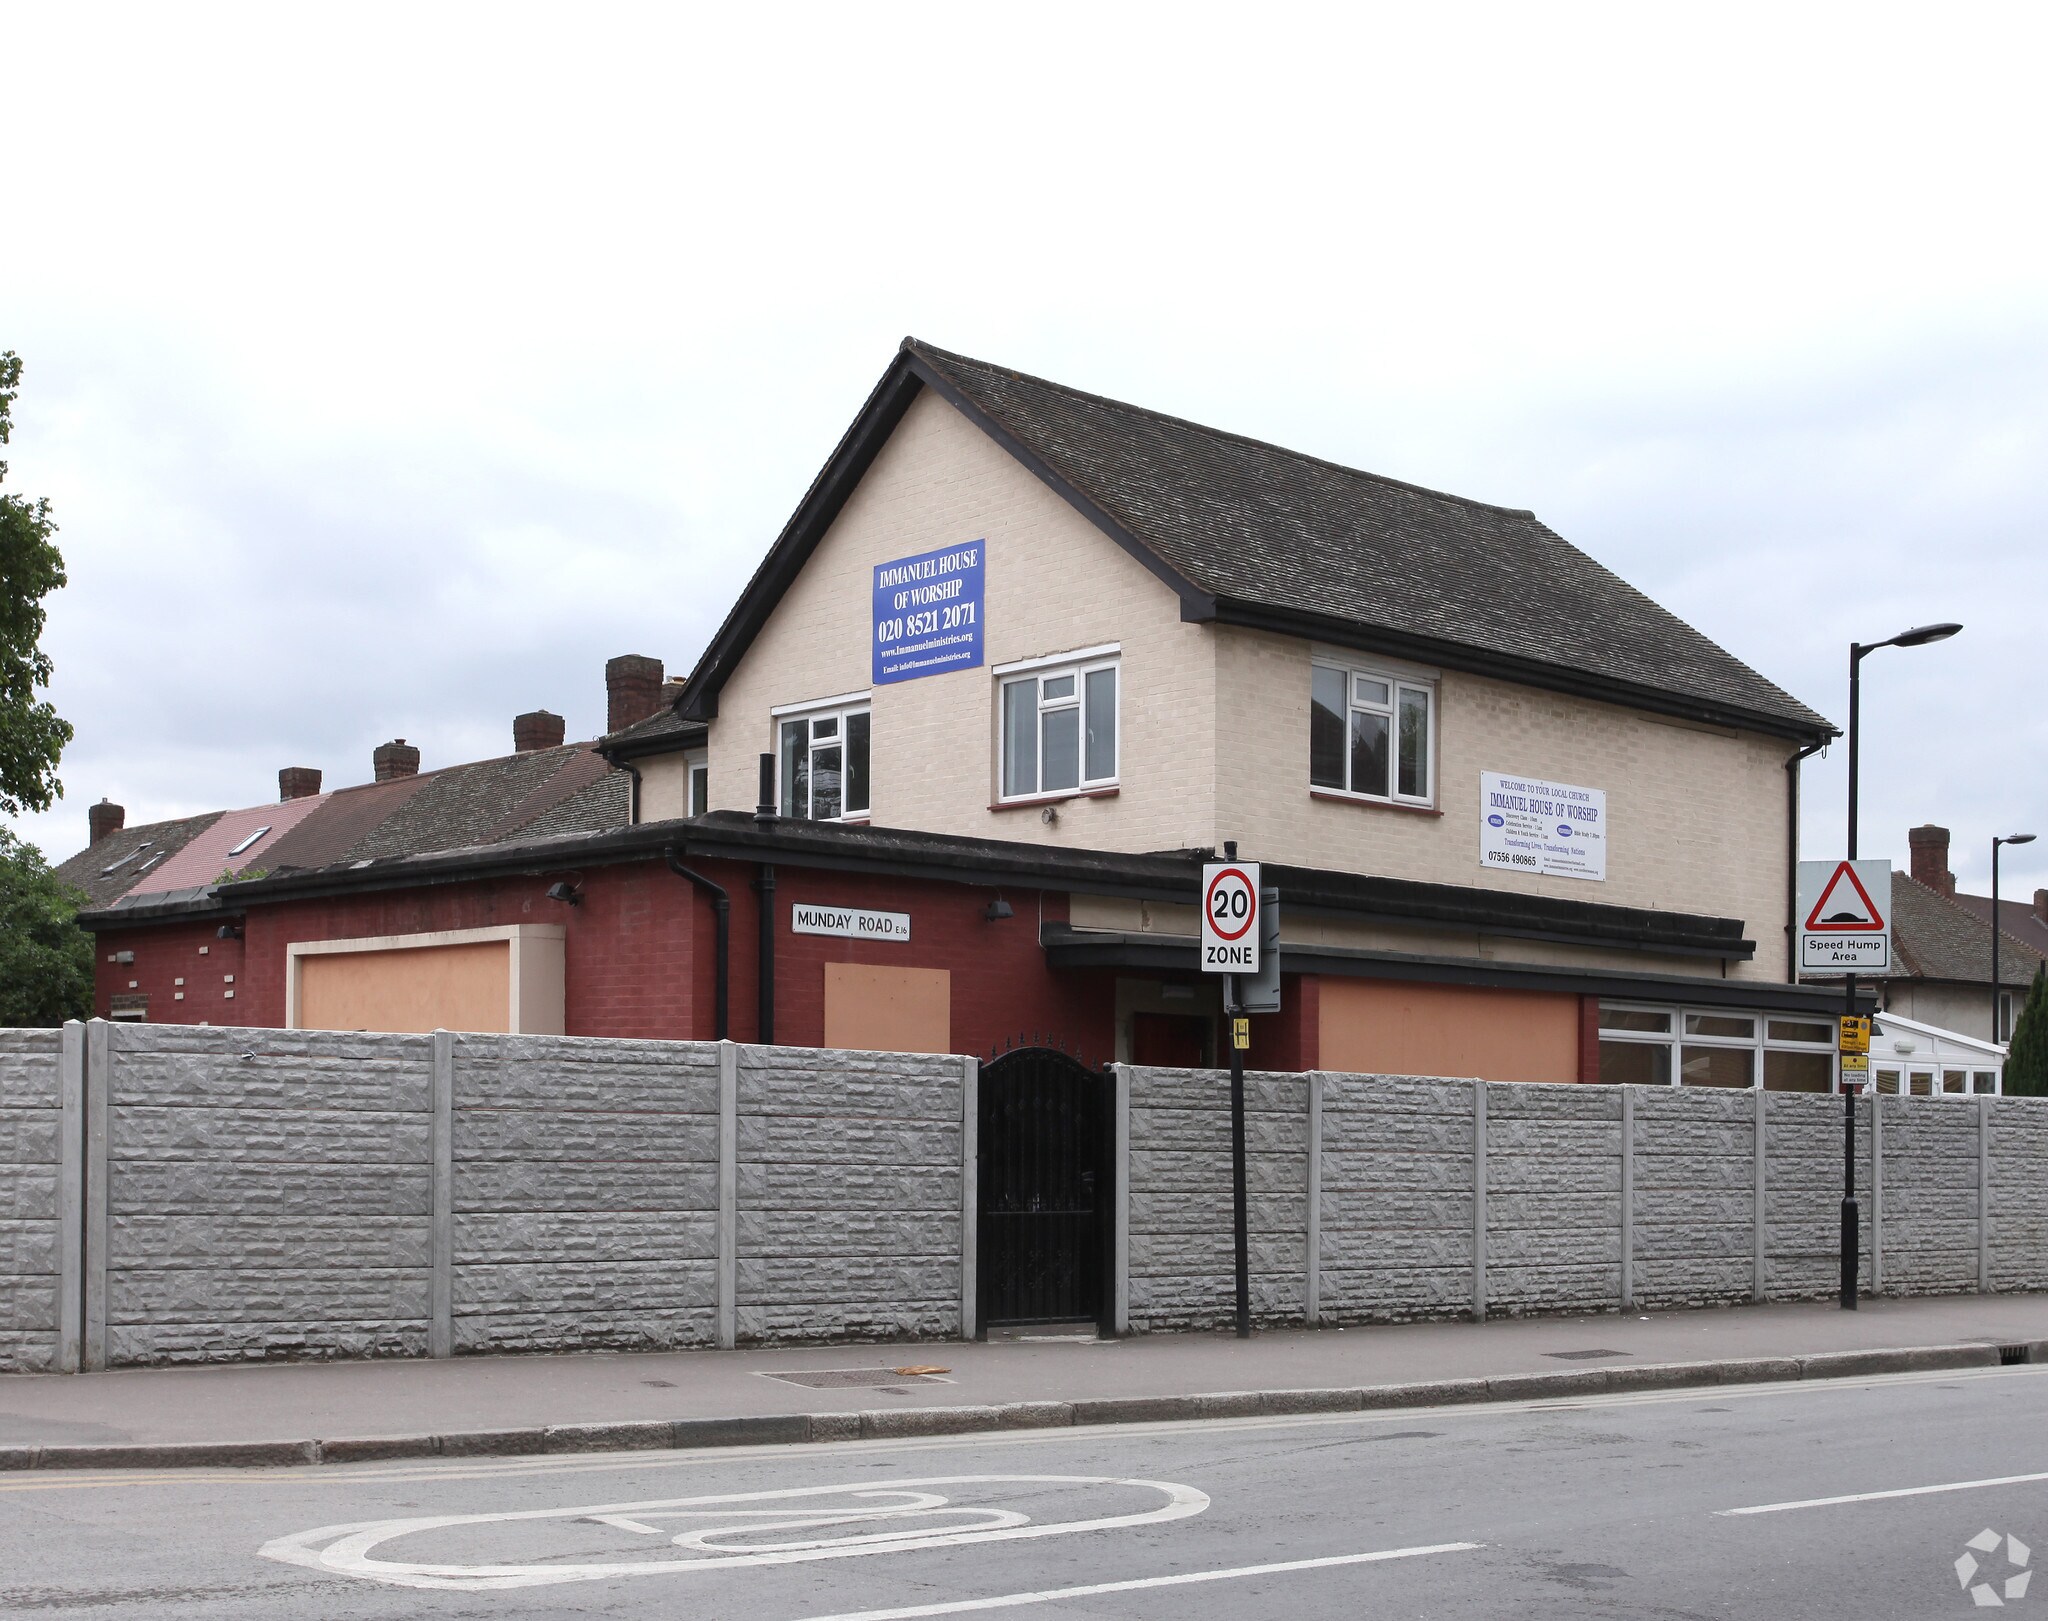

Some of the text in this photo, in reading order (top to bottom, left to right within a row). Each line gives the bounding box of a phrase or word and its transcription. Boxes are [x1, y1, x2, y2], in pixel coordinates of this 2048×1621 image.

[880, 549, 978, 589] IMMANUEL HOUSE
[894, 579, 963, 610] OF WORSHIP
[878, 601, 976, 643] 020 8521 2071
[1500, 780, 1590, 802] WELCOME TO YOUR LOCAL CHURCH
[1490, 792, 1598, 822] IMMANUEL HOUSE OF WORSHIP
[1488, 850, 1510, 863] 07556
[1511, 853, 1537, 866] 490865
[1504, 837, 1530, 850] Transforming
[1543, 843, 1569, 855] Transforming
[1570, 847, 1586, 856] Nations
[1213, 889, 1248, 919] 20
[797, 910, 852, 930] MUNDAY
[858, 916, 893, 933] ROAD
[1206, 946, 1253, 965] ZONE
[1809, 940, 1881, 951] Speed Hump
[1831, 951, 1857, 961] Area
[1235, 1022, 1248, 1046] H
